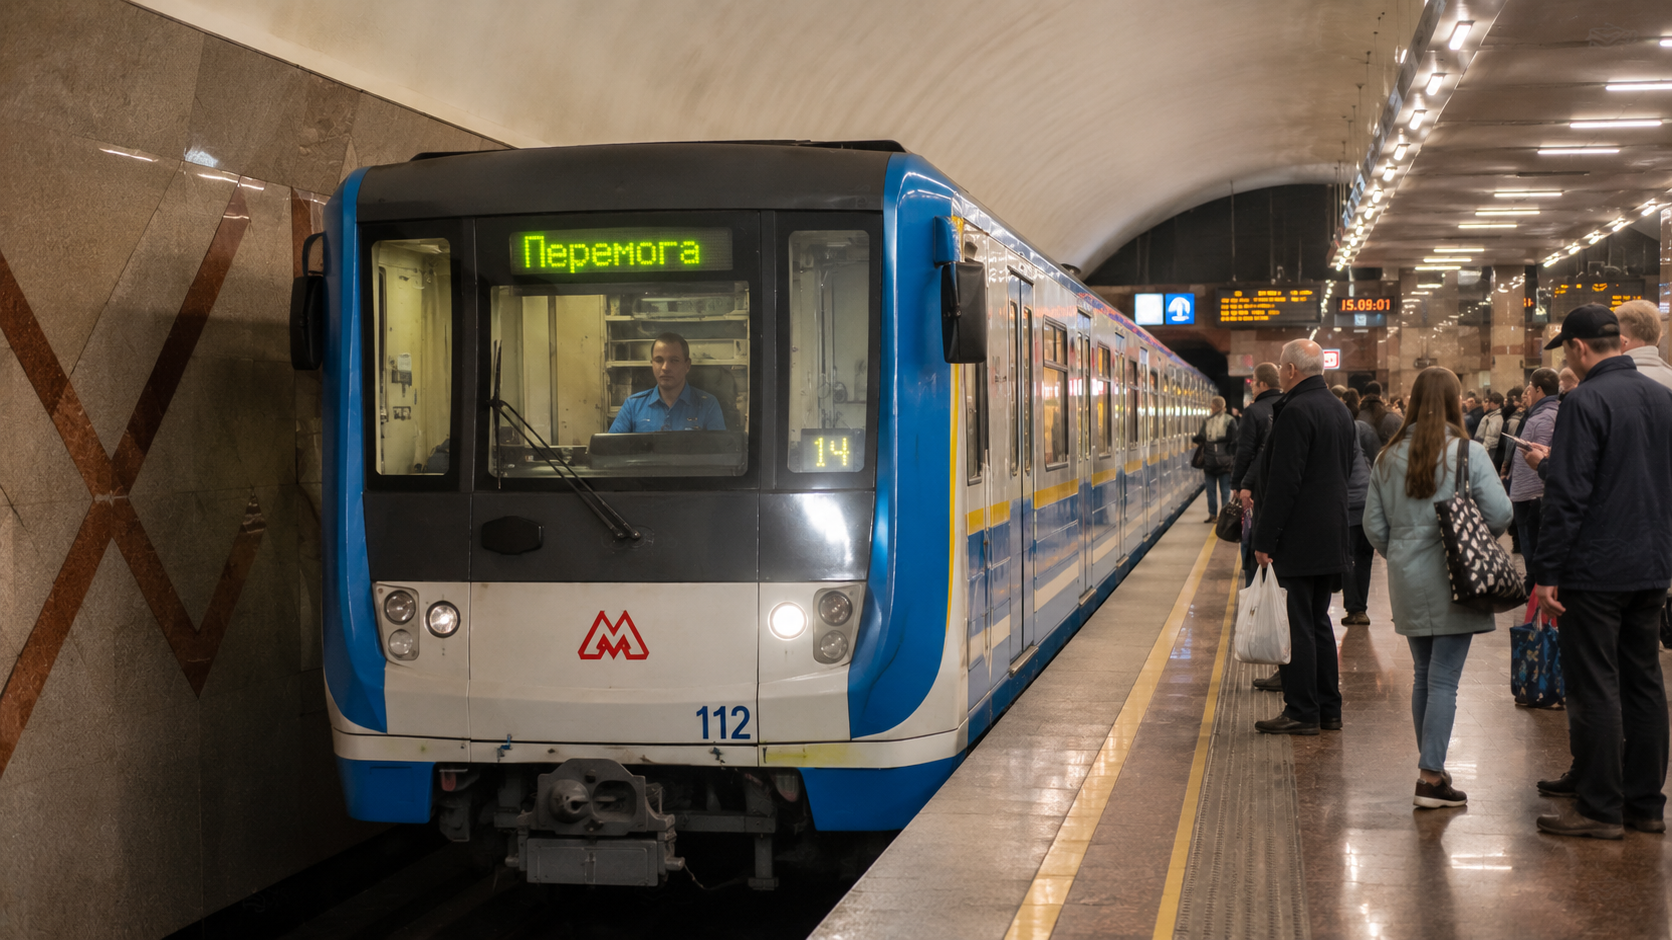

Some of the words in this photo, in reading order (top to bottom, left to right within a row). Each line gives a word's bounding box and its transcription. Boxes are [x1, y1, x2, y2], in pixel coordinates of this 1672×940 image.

[525, 235, 699, 273] Перемога
[1341, 298, 1391, 311] 15.09:01
[814, 437, 850, 467] 14
[696, 705, 751, 739] 112
